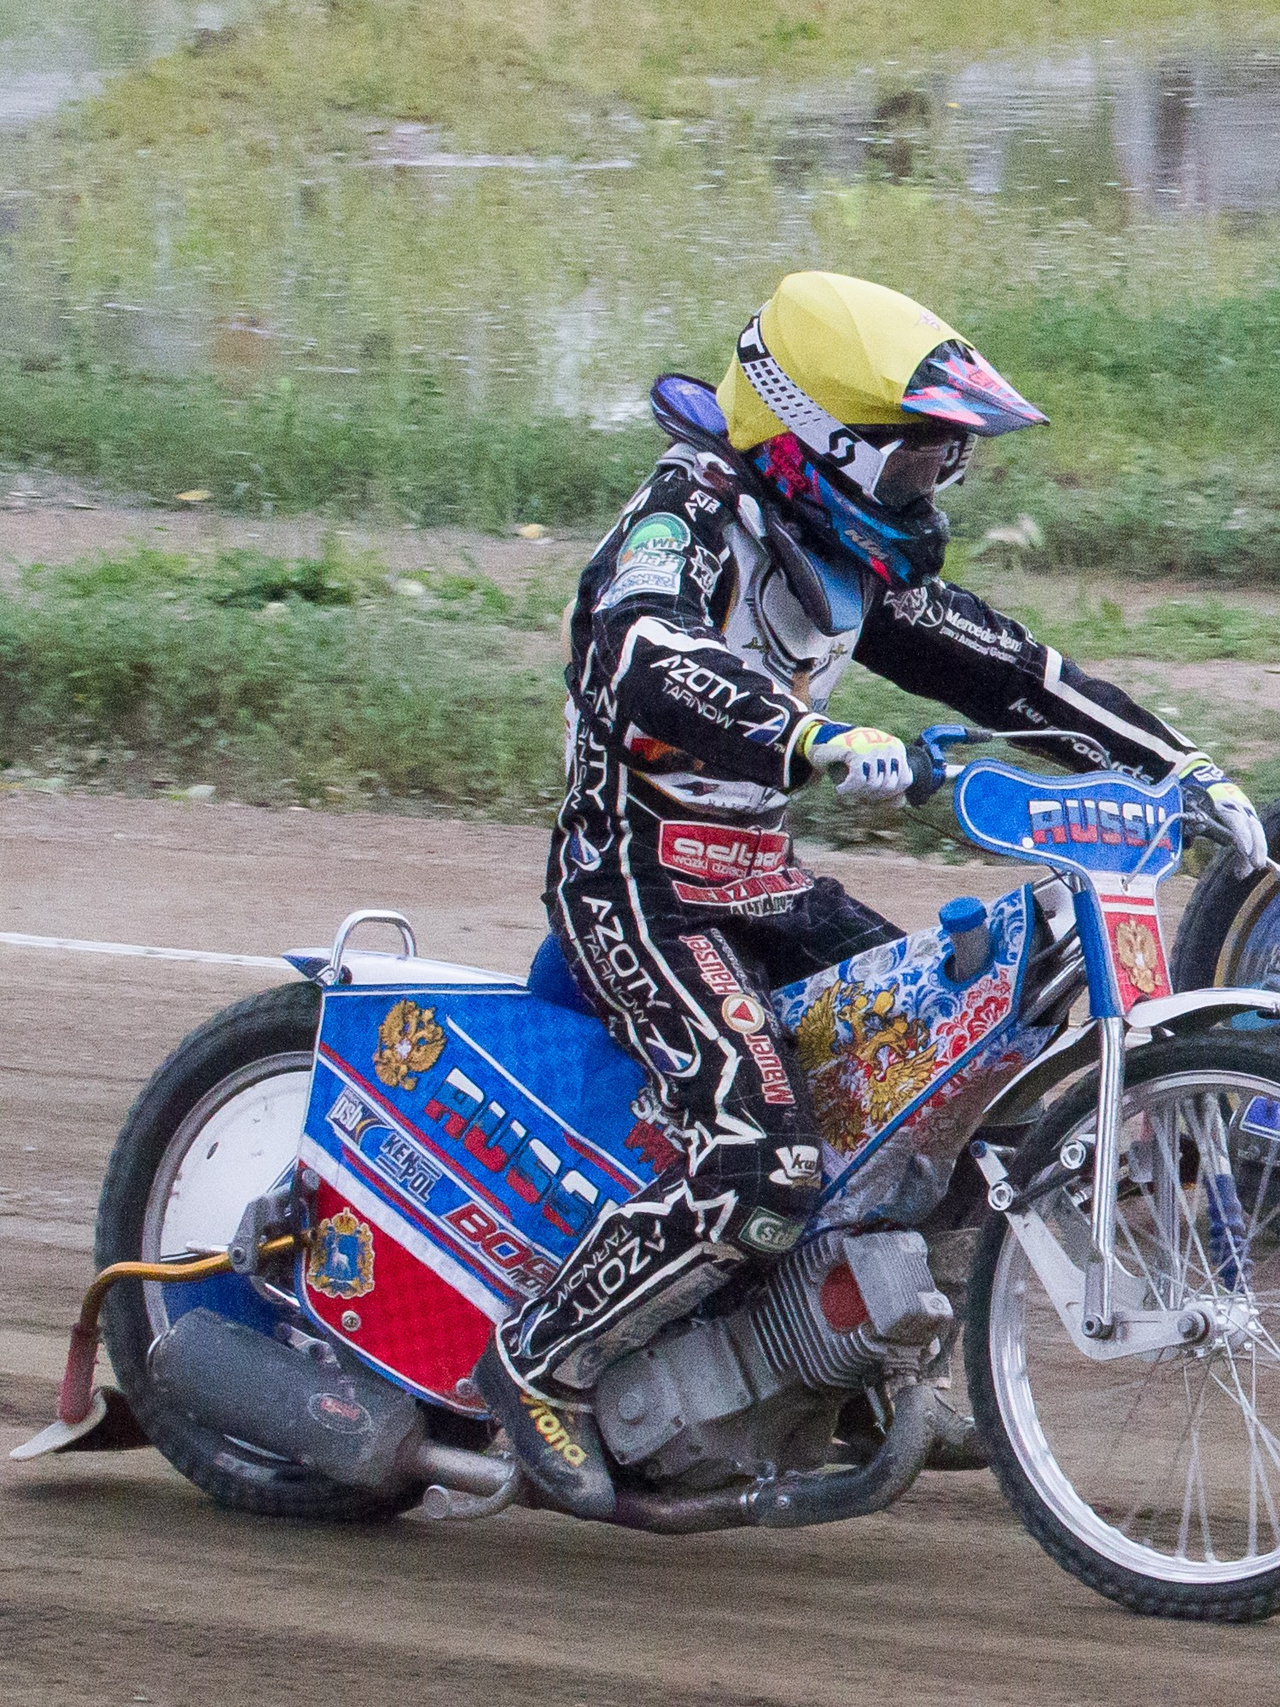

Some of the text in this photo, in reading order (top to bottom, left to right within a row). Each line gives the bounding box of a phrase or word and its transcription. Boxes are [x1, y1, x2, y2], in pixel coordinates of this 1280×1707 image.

[650, 655, 750, 710] AZOTY
[582, 895, 672, 1009] AZOTY
[744, 1033, 796, 1104] Mauer
[571, 1219, 666, 1327] AZOTY
